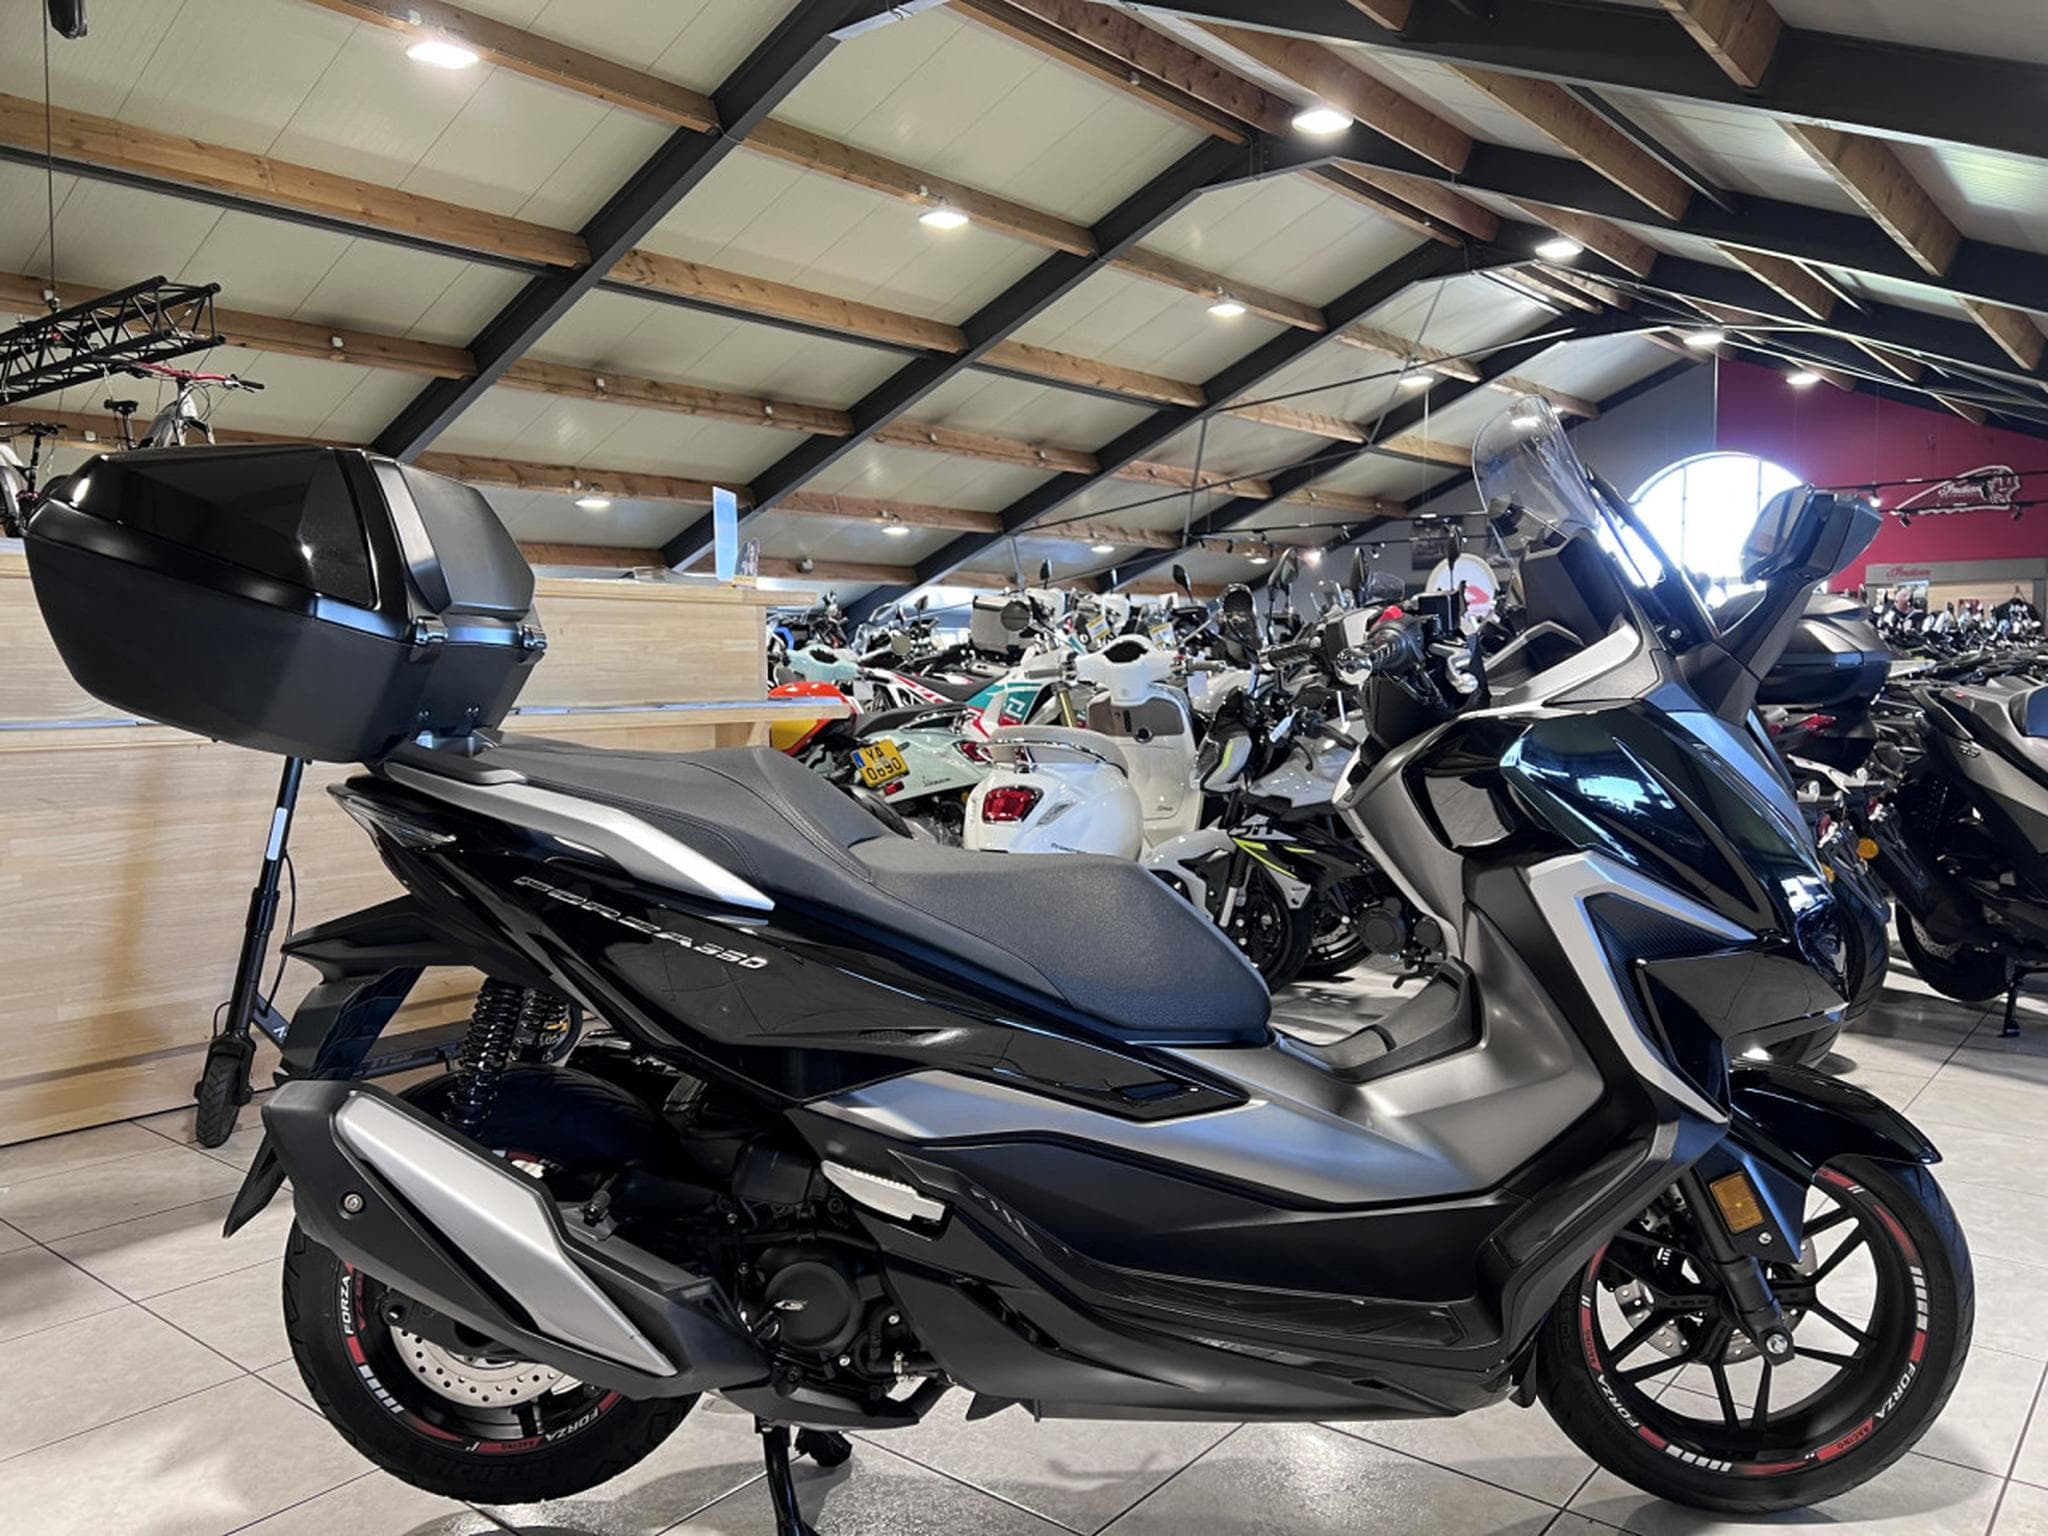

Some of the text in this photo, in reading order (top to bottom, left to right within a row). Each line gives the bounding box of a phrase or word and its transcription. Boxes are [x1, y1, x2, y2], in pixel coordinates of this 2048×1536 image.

[341, 1275, 354, 1334] FORZA
[1598, 1374, 1640, 1427] FORZA
[1874, 1362, 1916, 1418] FORZA
[545, 1407, 599, 1442] FORZA
